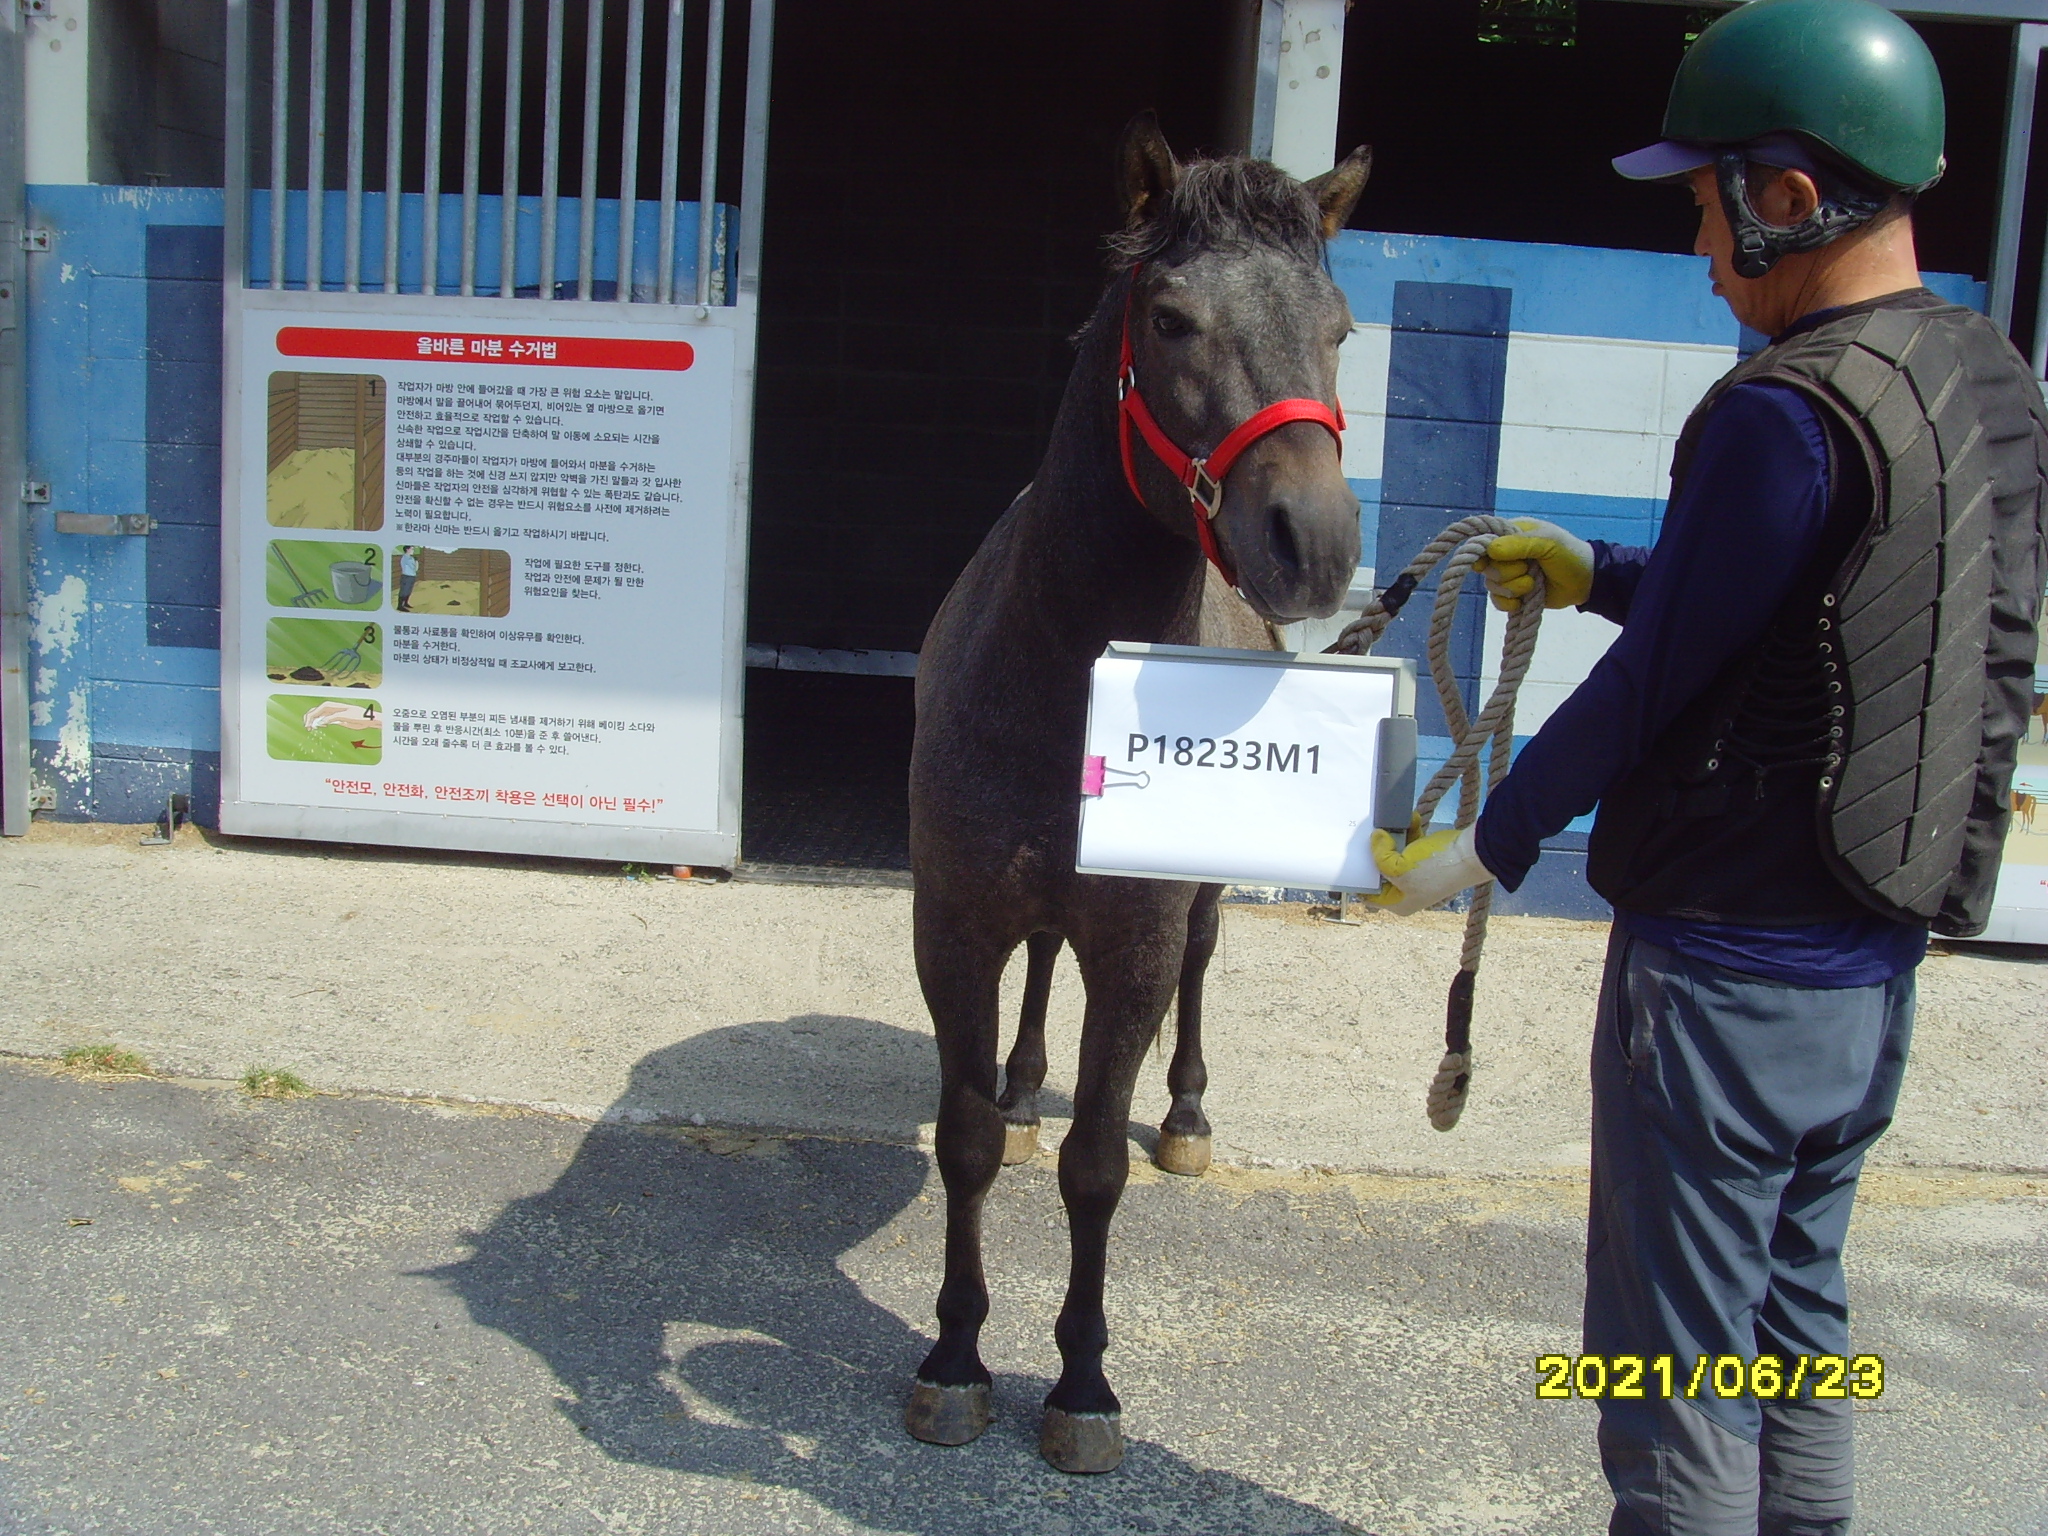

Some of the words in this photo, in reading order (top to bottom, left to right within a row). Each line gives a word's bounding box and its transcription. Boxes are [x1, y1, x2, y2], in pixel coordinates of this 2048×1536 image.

[416, 337, 465, 355] 올바른
[470, 340, 503, 356] 마분
[508, 340, 556, 359] 수거법
[368, 379, 376, 397] 1
[397, 381, 433, 392] 작업자가
[435, 382, 454, 393] 마방
[456, 383, 475, 394] 안에
[478, 384, 514, 396] 들어갔을
[516, 386, 526, 396] 때
[529, 386, 548, 397] 가장
[550, 387, 560, 397] 큰
[562, 387, 580, 399] 위험
[583, 388, 611, 400] 요소는
[614, 389, 653, 401] 말입니다.
[397, 395, 432, 406] 마방에서
[435, 397, 453, 407] 말을
[456, 397, 492, 409] 끌어내어
[546, 401, 582, 413] 비어있는
[585, 402, 594, 413] 옆
[597, 403, 634, 414] 마방으로
[637, 404, 664, 416] 옮기면
[396, 409, 432, 420] 안전하고
[434, 411, 480, 422] 효율적으로
[482, 413, 510, 424] 작업할
[512, 414, 522, 424] 수
[525, 414, 564, 426] 있습니다.
[396, 423, 423, 435] 신속한
[426, 425, 462, 436] 작업으로
[464, 426, 509, 438] 작업시간을
[512, 428, 548, 440] 단축하여
[551, 430, 560, 440] 말
[563, 430, 590, 442] 이동에
[593, 432, 630, 443] 소요되는
[632, 433, 660, 445] 시간을
[396, 437, 423, 449] 상쇄할
[425, 438, 435, 449] 수
[438, 439, 476, 451] 있습니다.
[396, 452, 431, 463] 대부분의
[434, 453, 478, 465] 경주마들이
[482, 455, 518, 467] 작업자가
[520, 457, 547, 468] 마방에
[550, 458, 586, 470] 들어와서
[589, 460, 616, 471] 마분을
[619, 461, 656, 473] 수거하는
[395, 466, 413, 476] 등의
[416, 467, 443, 478] 작업을
[446, 468, 464, 479] 하는
[467, 469, 485, 480] 것에
[488, 470, 506, 481] 신경
[508, 471, 527, 482] 쓰지
[530, 472, 557, 483] 않지만
[560, 473, 587, 484] 악벽을
[590, 474, 608, 485] 가진
[611, 475, 639, 486] 말들과
[642, 477, 652, 487] 갓
[654, 477, 682, 489] 입사한
[395, 480, 430, 491] 신마들은
[433, 482, 469, 493] 작업자의
[472, 483, 498, 495] 안전을
[502, 484, 538, 496] 심각하게
[540, 486, 568, 498] 위협할
[570, 487, 580, 498] 수
[583, 488, 601, 499] 있는
[604, 489, 640, 501] 폭탄과도
[644, 491, 682, 503] 같습니다.
[394, 508, 421, 519] 노력이
[424, 509, 472, 522] 필요합니다.
[395, 494, 422, 505] 안전을
[424, 495, 452, 506] 확신할
[454, 496, 463, 507] 수
[466, 497, 484, 508] 없는
[488, 498, 514, 509] 경우는
[517, 499, 544, 511] 반드시
[547, 500, 592, 513] 위험요소를
[594, 503, 622, 514] 사전에
[624, 504, 670, 517] 제거하려는
[434, 524, 460, 535] 신마는
[463, 525, 490, 536] 반드시
[493, 526, 520, 537] 옮기고
[522, 528, 567, 540] 작업하시기
[570, 530, 609, 542] 바랍니다.
[364, 547, 376, 566] 2
[524, 558, 551, 569] 작업에
[554, 559, 581, 570] 필요한
[584, 561, 611, 572] 도구를
[614, 562, 644, 574] 정한다.
[524, 572, 551, 583] 작업과
[553, 573, 580, 584] 안전에
[583, 575, 611, 586] 문제가
[614, 576, 623, 587] 될
[626, 577, 644, 588] 만한
[524, 585, 568, 598] 위험요인을
[571, 588, 601, 600] 찾는다.
[363, 625, 376, 644] 3
[393, 624, 420, 636] 물통과
[422, 626, 458, 638] 사료통을
[460, 628, 496, 640] 확인하여
[499, 630, 543, 642] 이상유무를
[546, 632, 584, 645] 확인한다.
[393, 638, 420, 650] 마분을
[422, 640, 460, 652] 수거한다.
[393, 652, 419, 663] 마분의
[422, 654, 448, 665] 상태가
[451, 655, 495, 668] 비정상적일
[498, 658, 507, 668] 때
[510, 659, 554, 671] 조교사에게
[557, 661, 596, 673] 보고한다.
[363, 703, 376, 721] 4
[392, 708, 428, 719] 오줌으로
[430, 710, 456, 721] 오염된
[459, 711, 486, 723] 부분의
[488, 713, 506, 724] 찌든
[509, 715, 536, 726] 냄새를
[539, 716, 574, 728] 제거하기
[577, 718, 595, 729] 위해
[598, 720, 625, 731] 베이킹
[628, 721, 655, 732] 소다와
[392, 721, 410, 732] 물을
[413, 723, 430, 733] 뿌린
[433, 723, 442, 733] 후
[504, 728, 536, 740] 10분)을
[538, 730, 548, 740] 준
[550, 730, 560, 741] 후
[392, 735, 418, 746] 시간을
[421, 737, 439, 747] 오래
[471, 740, 480, 750] 더
[483, 740, 492, 751] 큰
[494, 741, 521, 752] 효과를
[524, 743, 533, 753] 볼
[536, 744, 546, 754] 수
[548, 744, 569, 755] 있다.
[1127, 733, 1321, 775] P18233M1
[382, 782, 428, 799] 안전화,
[434, 785, 489, 803] 안전조끼
[494, 789, 536, 806] 착용은
[541, 792, 583, 809] 선택이
[589, 795, 616, 811] 아닌
